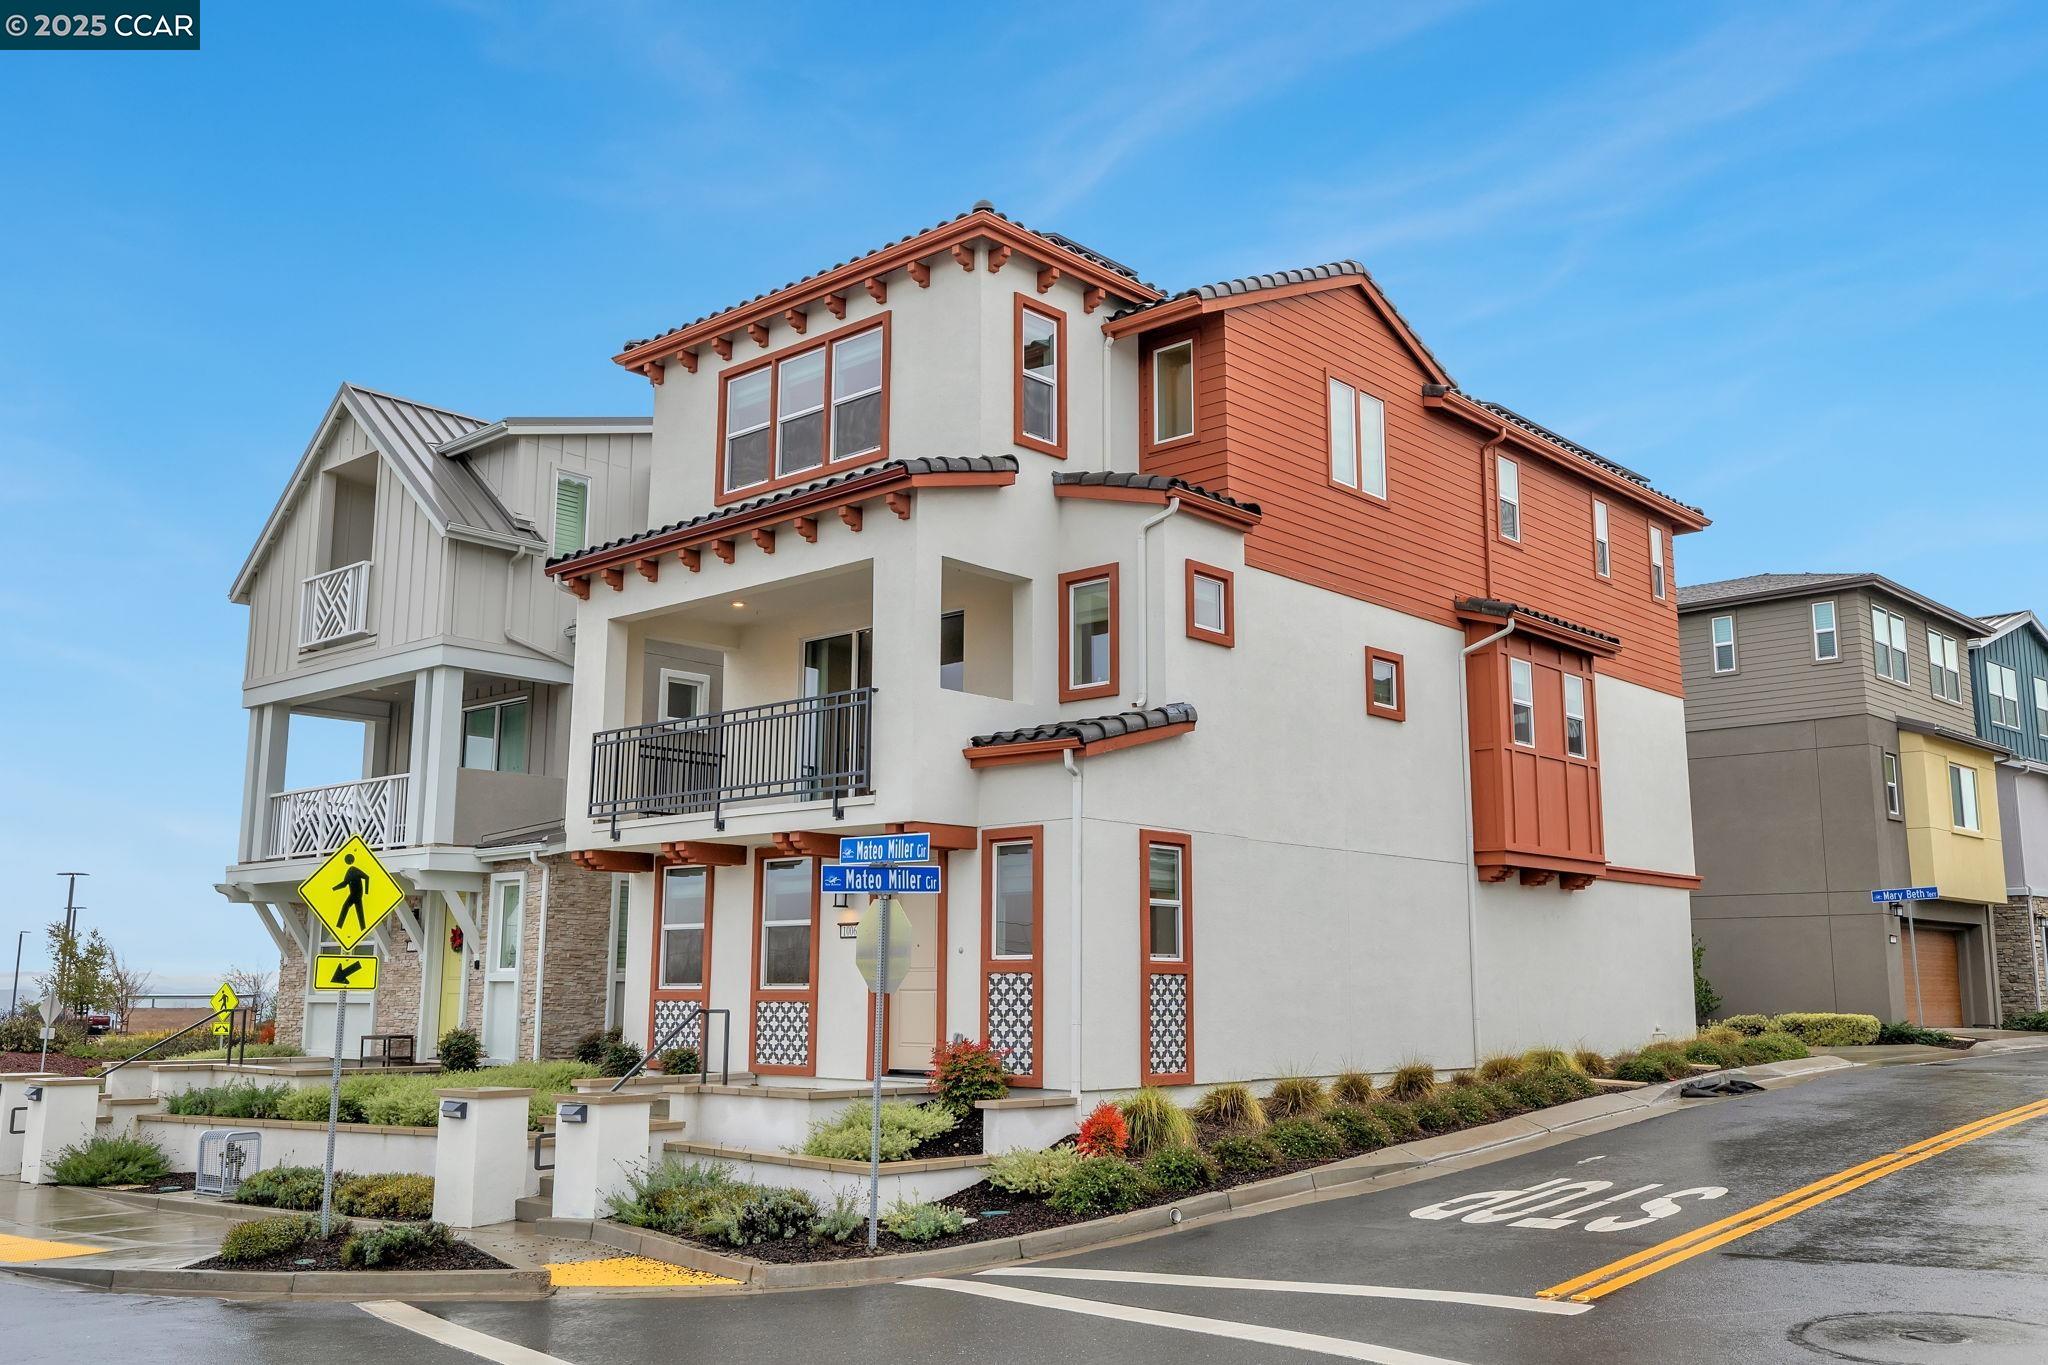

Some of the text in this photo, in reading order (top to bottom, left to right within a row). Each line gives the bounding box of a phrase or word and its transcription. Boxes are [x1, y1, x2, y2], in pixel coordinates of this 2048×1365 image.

[856, 838, 926, 860] Mateo Miller Cir
[845, 868, 937, 890] Mateo Miller Cir
[1883, 891, 1903, 901] Mary
[1906, 889, 1925, 899] Beth
